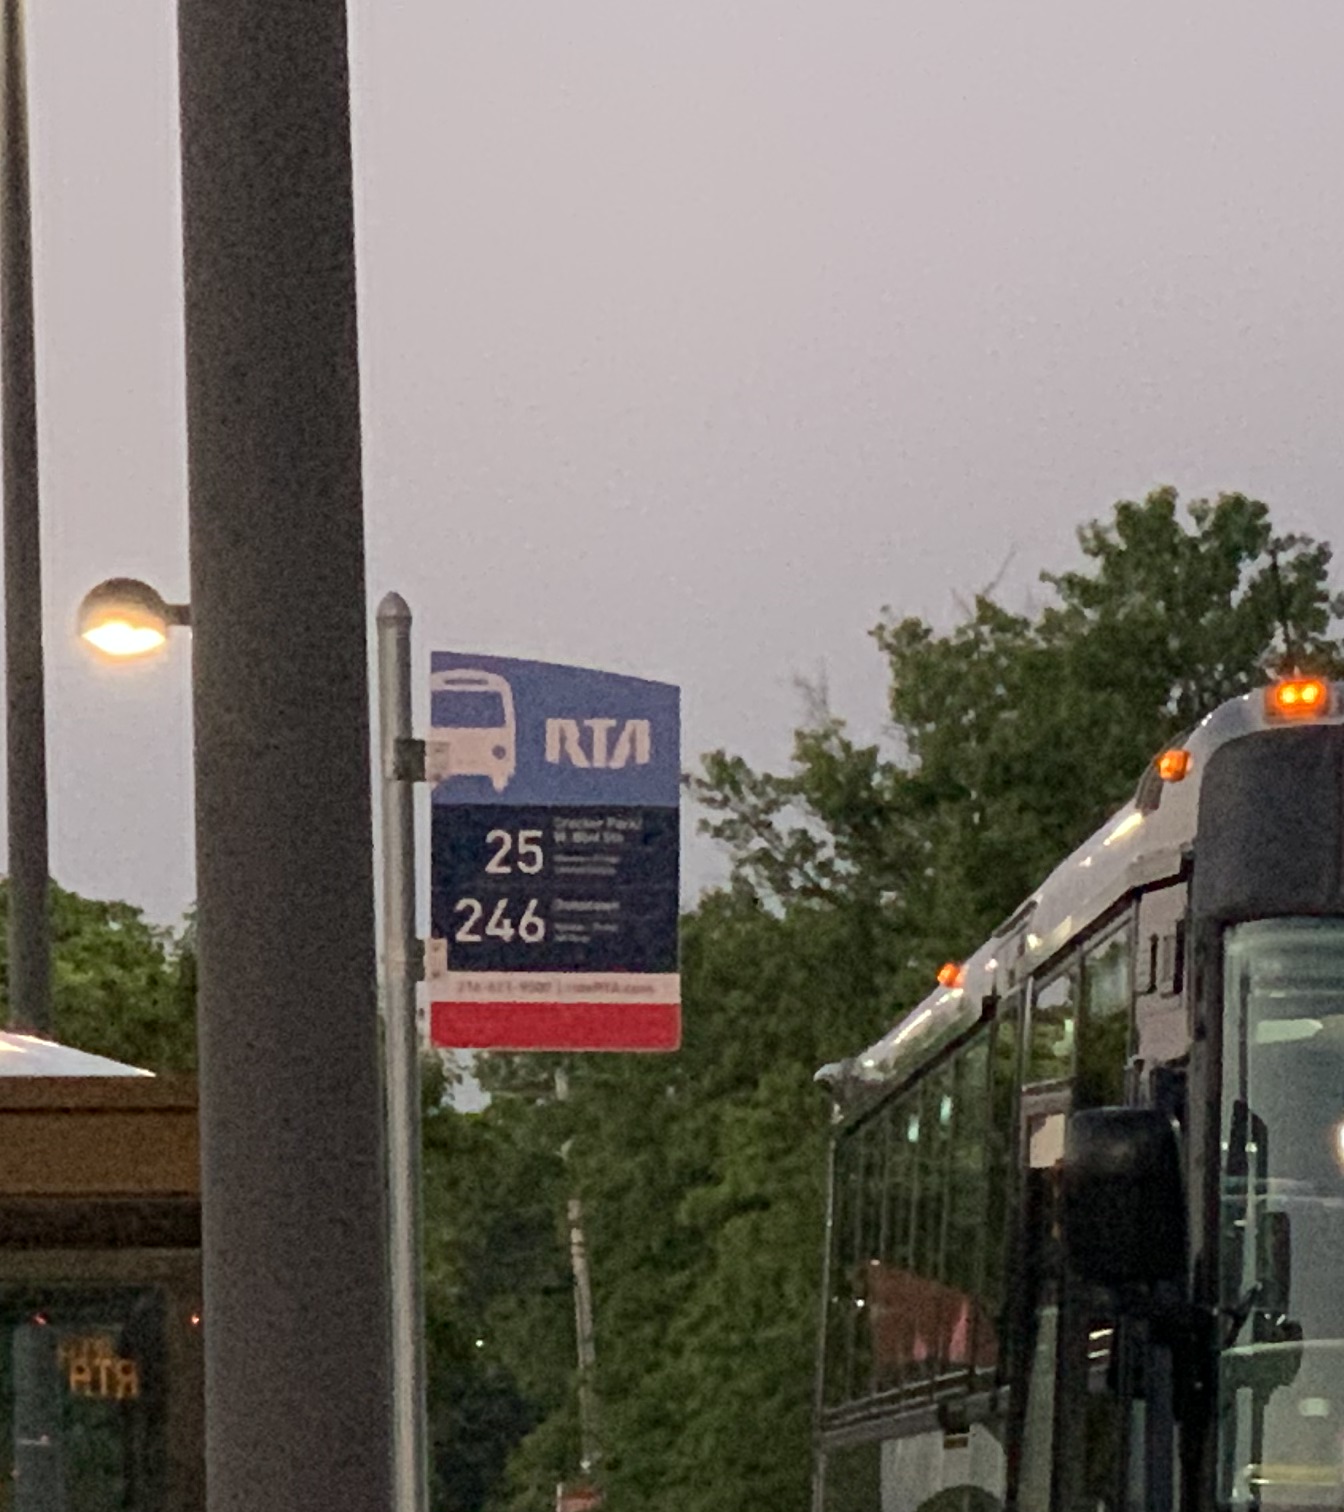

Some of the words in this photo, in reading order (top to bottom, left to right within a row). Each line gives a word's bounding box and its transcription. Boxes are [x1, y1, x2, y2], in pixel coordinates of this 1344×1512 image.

[545, 718, 651, 769] RTA
[484, 829, 544, 875] 25
[454, 898, 546, 943] 246
